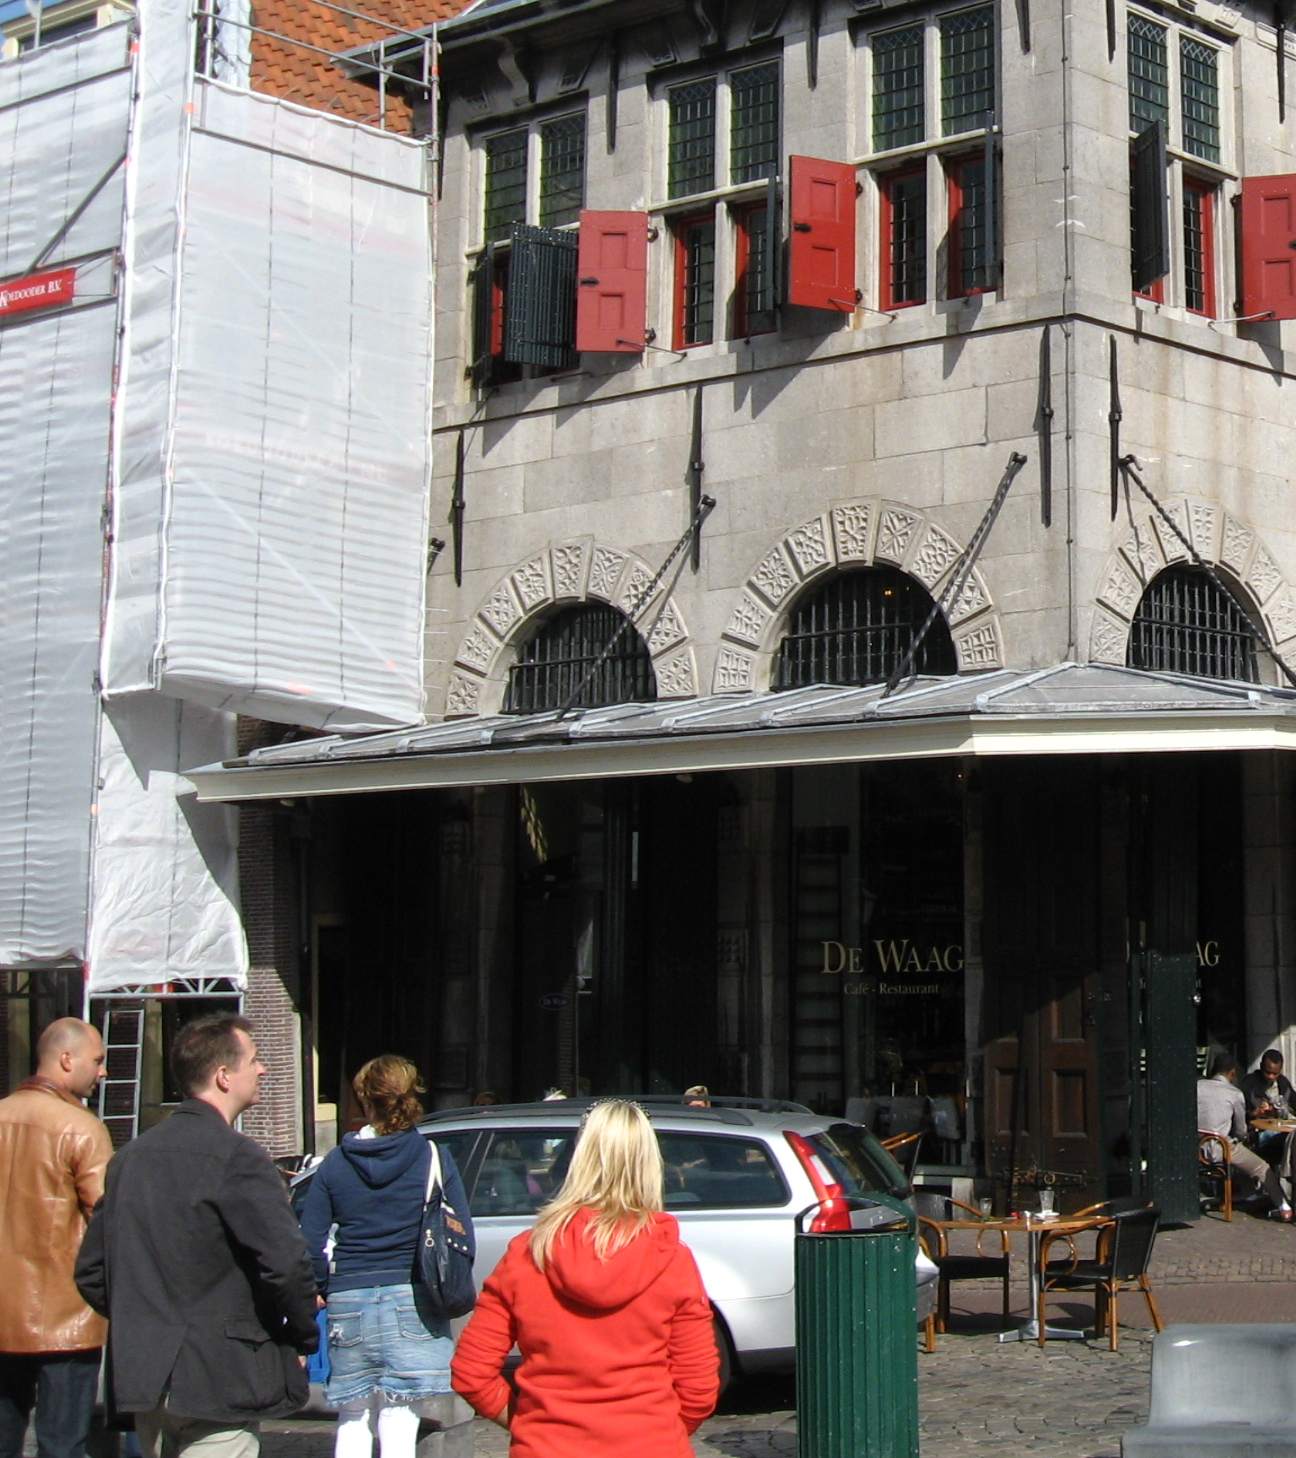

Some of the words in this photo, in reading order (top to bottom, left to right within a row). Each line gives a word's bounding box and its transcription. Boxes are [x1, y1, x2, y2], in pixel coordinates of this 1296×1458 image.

[820, 941, 865, 974] DE
[873, 939, 965, 972] WAAG
[843, 983, 870, 995] Café
[879, 983, 940, 995] Restaurant
